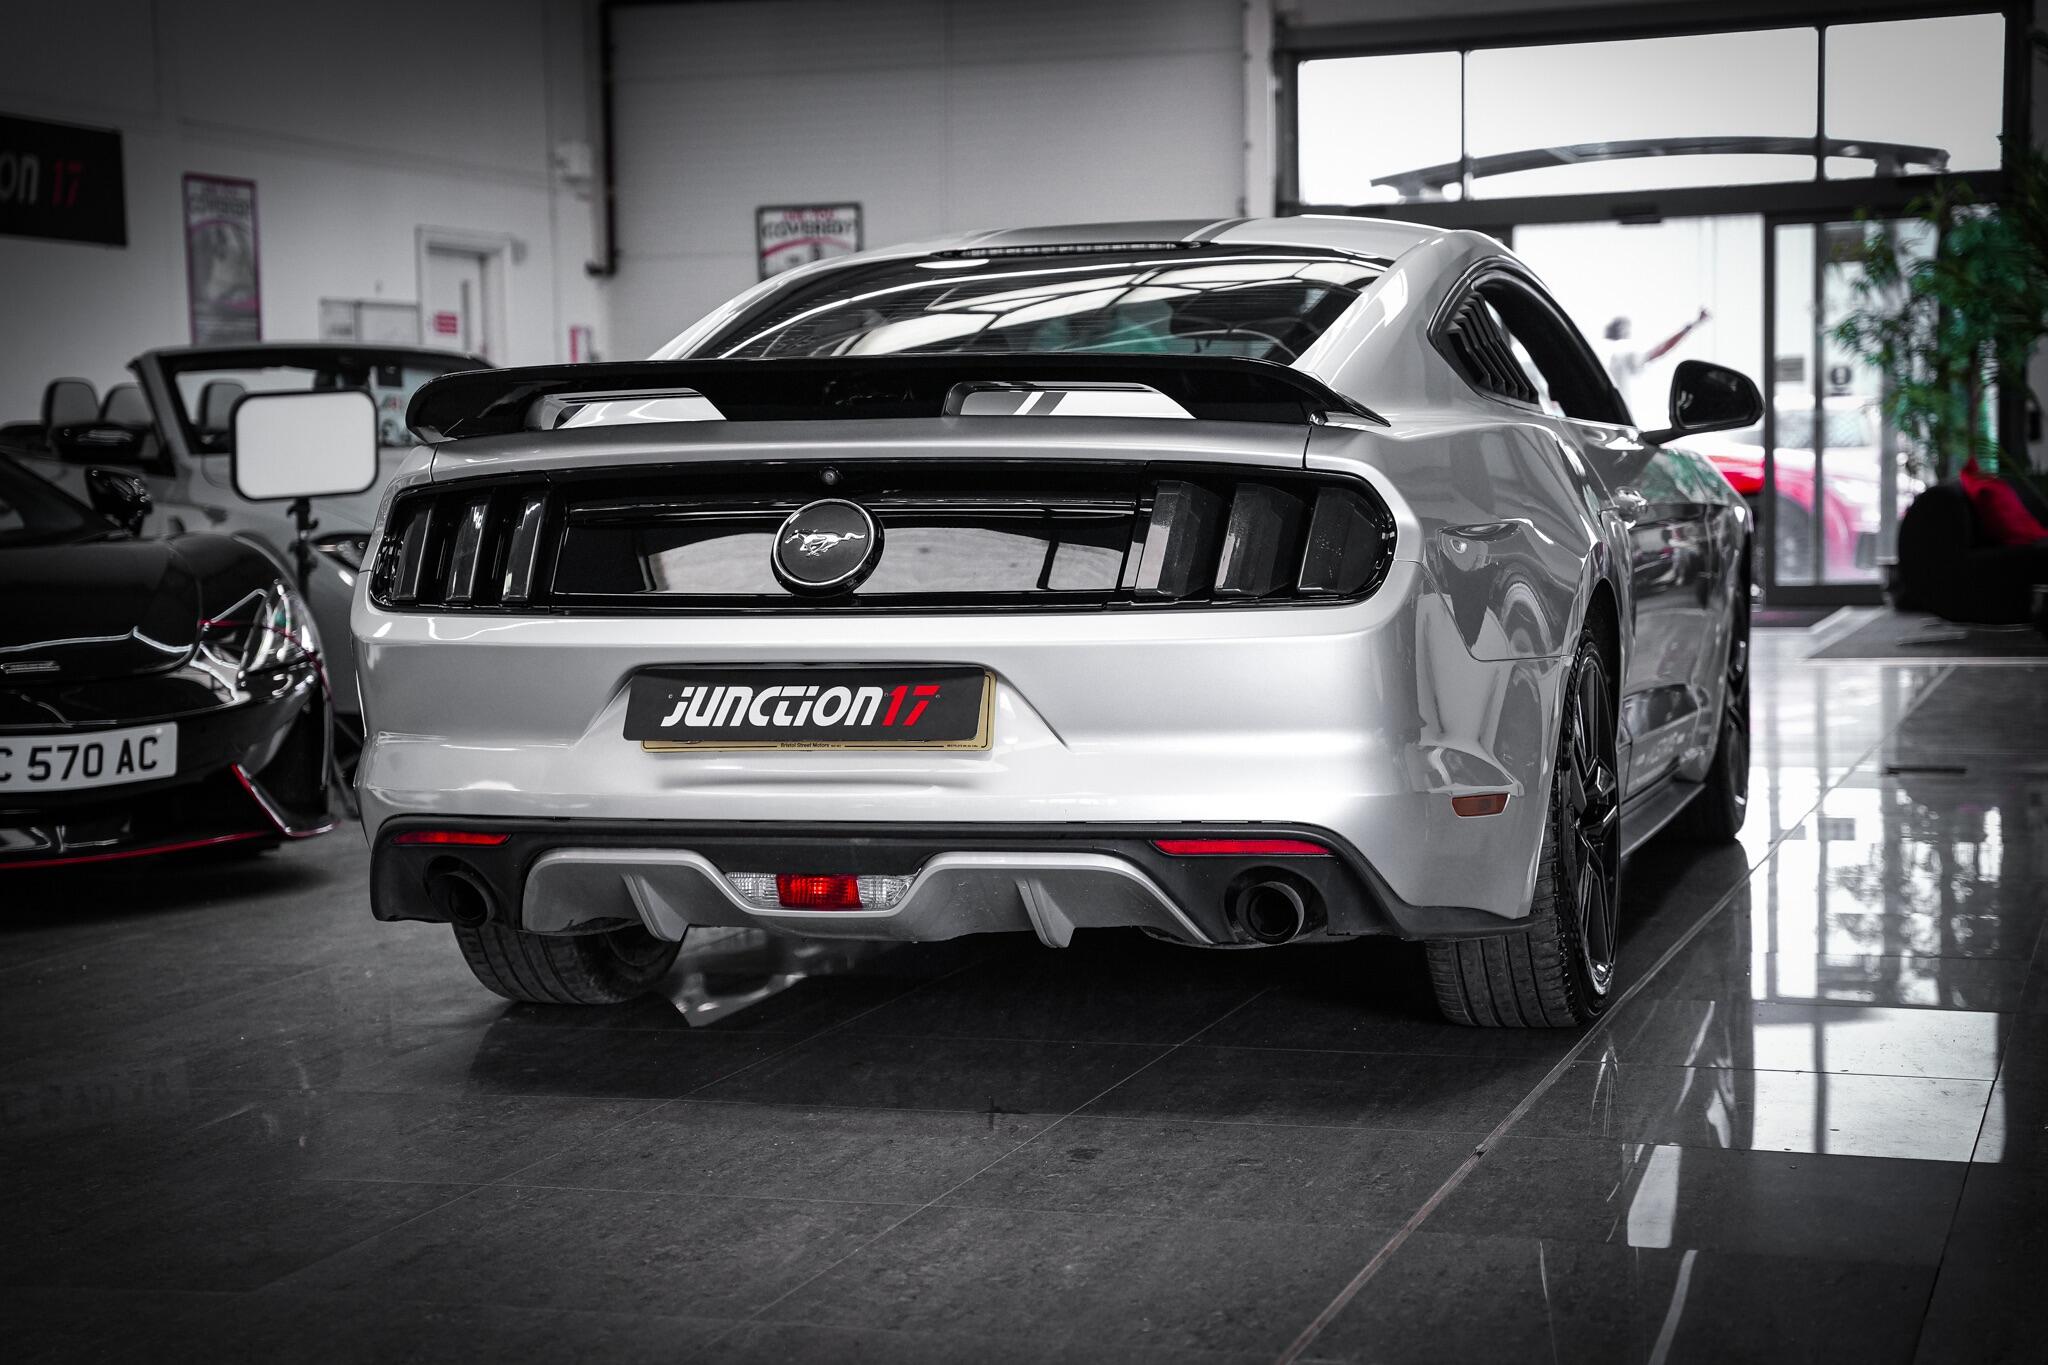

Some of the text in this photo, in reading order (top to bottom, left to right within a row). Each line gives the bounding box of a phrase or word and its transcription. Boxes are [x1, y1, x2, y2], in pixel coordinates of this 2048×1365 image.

[52, 160, 84, 207] 17
[28, 743, 104, 782] 570
[116, 736, 158, 775] AC
